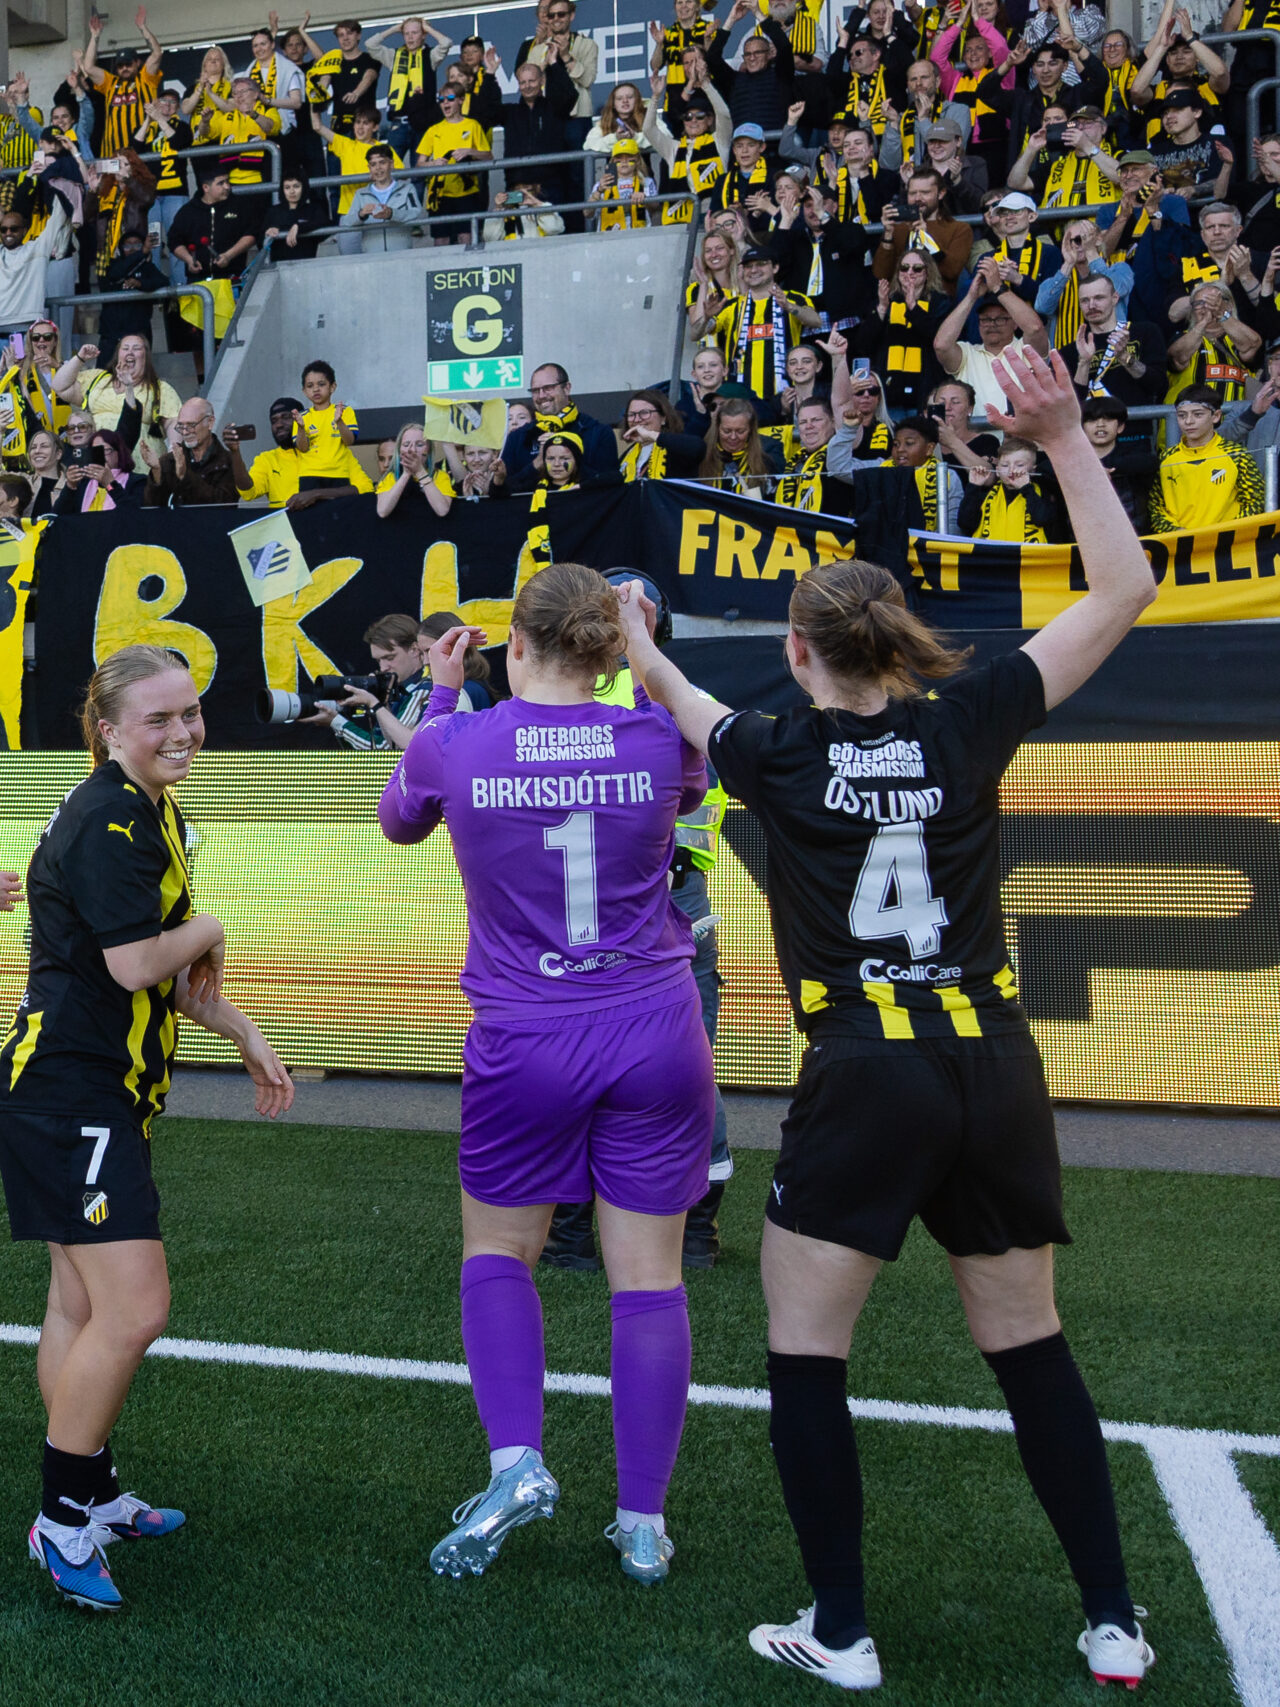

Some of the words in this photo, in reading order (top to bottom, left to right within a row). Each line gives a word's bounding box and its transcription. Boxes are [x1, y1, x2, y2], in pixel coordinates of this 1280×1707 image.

[433, 267, 516, 290] SEKTON
[452, 294, 503, 355] G
[515, 724, 614, 747] GÖTEBORGS
[860, 731, 896, 746] HISINGEN
[515, 743, 617, 762] STADSMISSION
[828, 740, 923, 762] GÖTEBORGS
[472, 770, 655, 808] BIRKISDÓTTIR
[543, 811, 600, 946] 1
[848, 820, 951, 961] 4
[886, 964, 962, 981] ColliCare
[81, 1126, 111, 1185] 7
